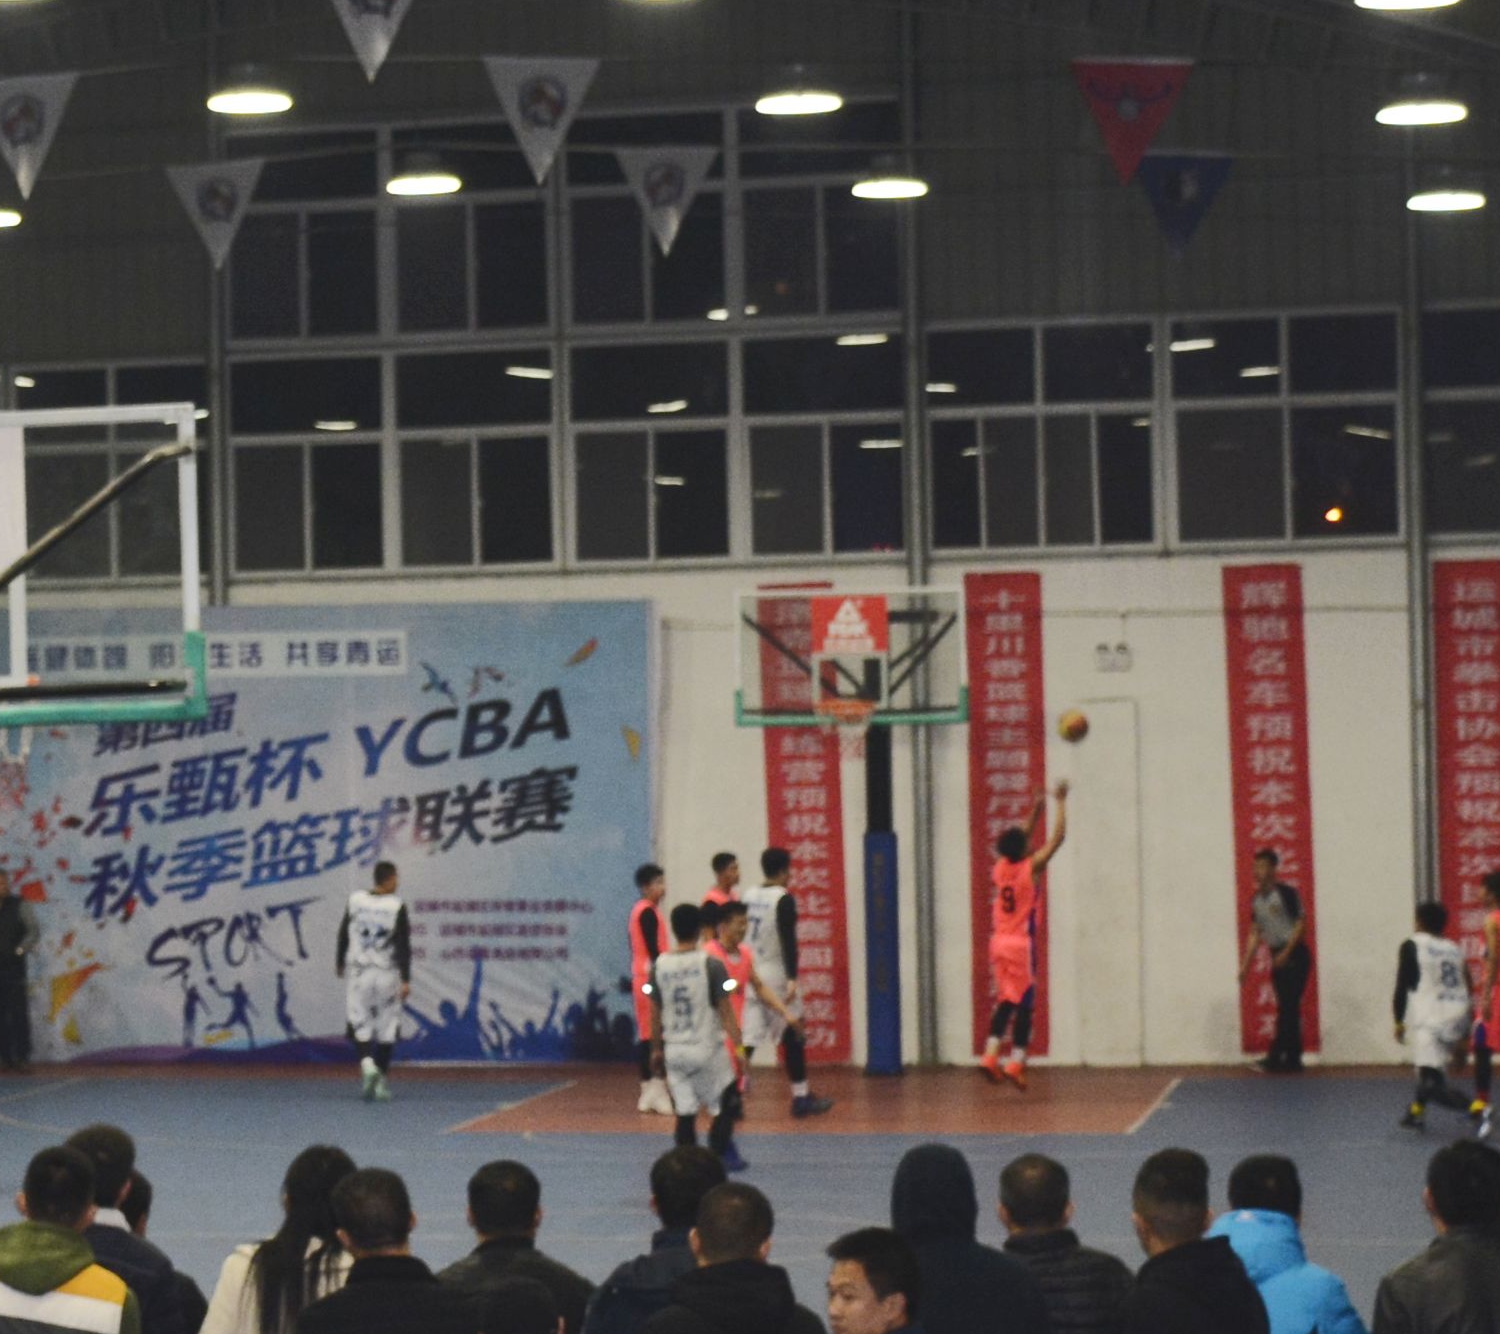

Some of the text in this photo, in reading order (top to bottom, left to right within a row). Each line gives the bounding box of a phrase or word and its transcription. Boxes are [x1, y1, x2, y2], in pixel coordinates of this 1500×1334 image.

[354, 687, 572, 777] YCBA
[83, 765, 579, 923] 秋季篮球联赛
[1000, 884, 1017, 914] 9
[671, 985, 694, 1017] 5
